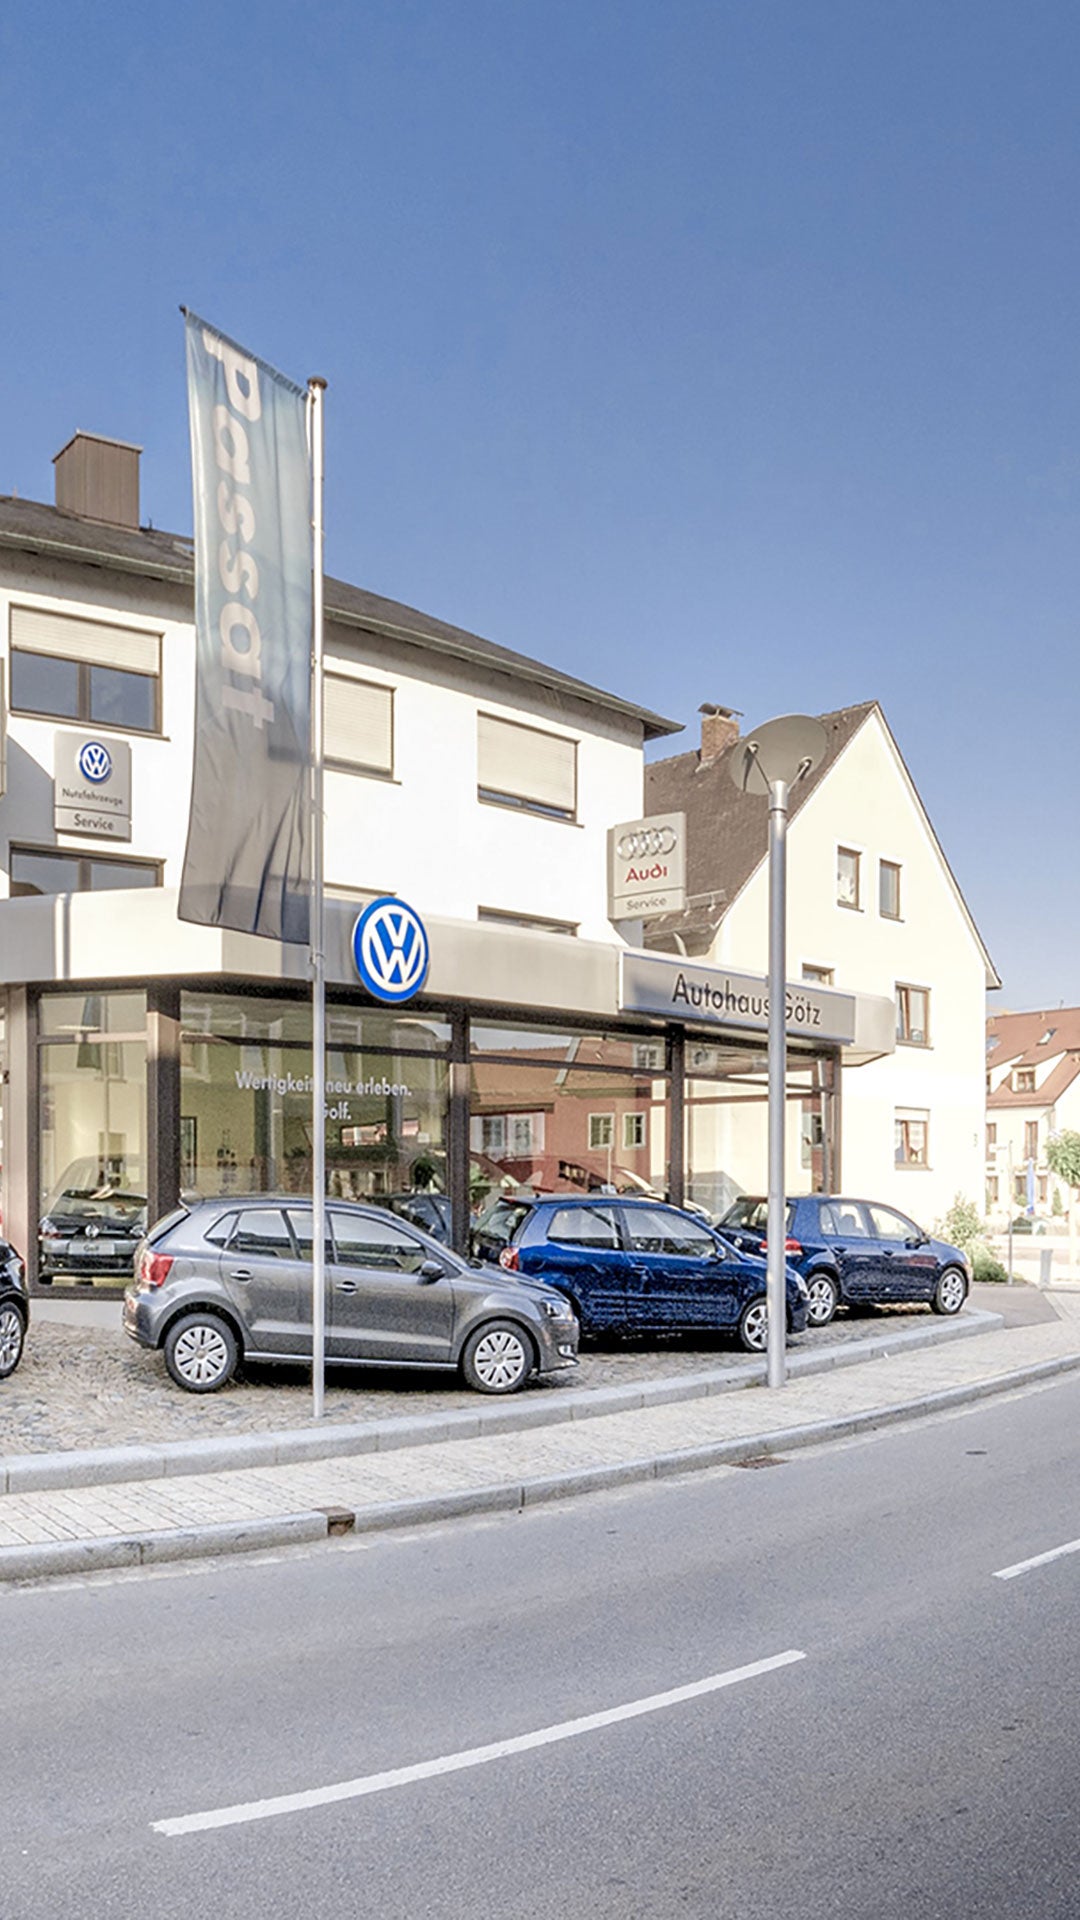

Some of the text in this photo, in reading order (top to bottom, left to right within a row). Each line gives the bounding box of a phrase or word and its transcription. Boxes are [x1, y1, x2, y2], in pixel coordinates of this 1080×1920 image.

[203, 328, 275, 730] Passat
[62, 787, 123, 806] Nutzfahrzeuge
[74, 813, 114, 831] Service
[625, 863, 668, 883] Audi
[626, 897, 667, 911] Service
[361, 905, 425, 993] VW
[672, 973, 769, 1017] Autohaus
[326, 1081, 351, 1094] neu
[356, 1077, 412, 1097] erleben.
